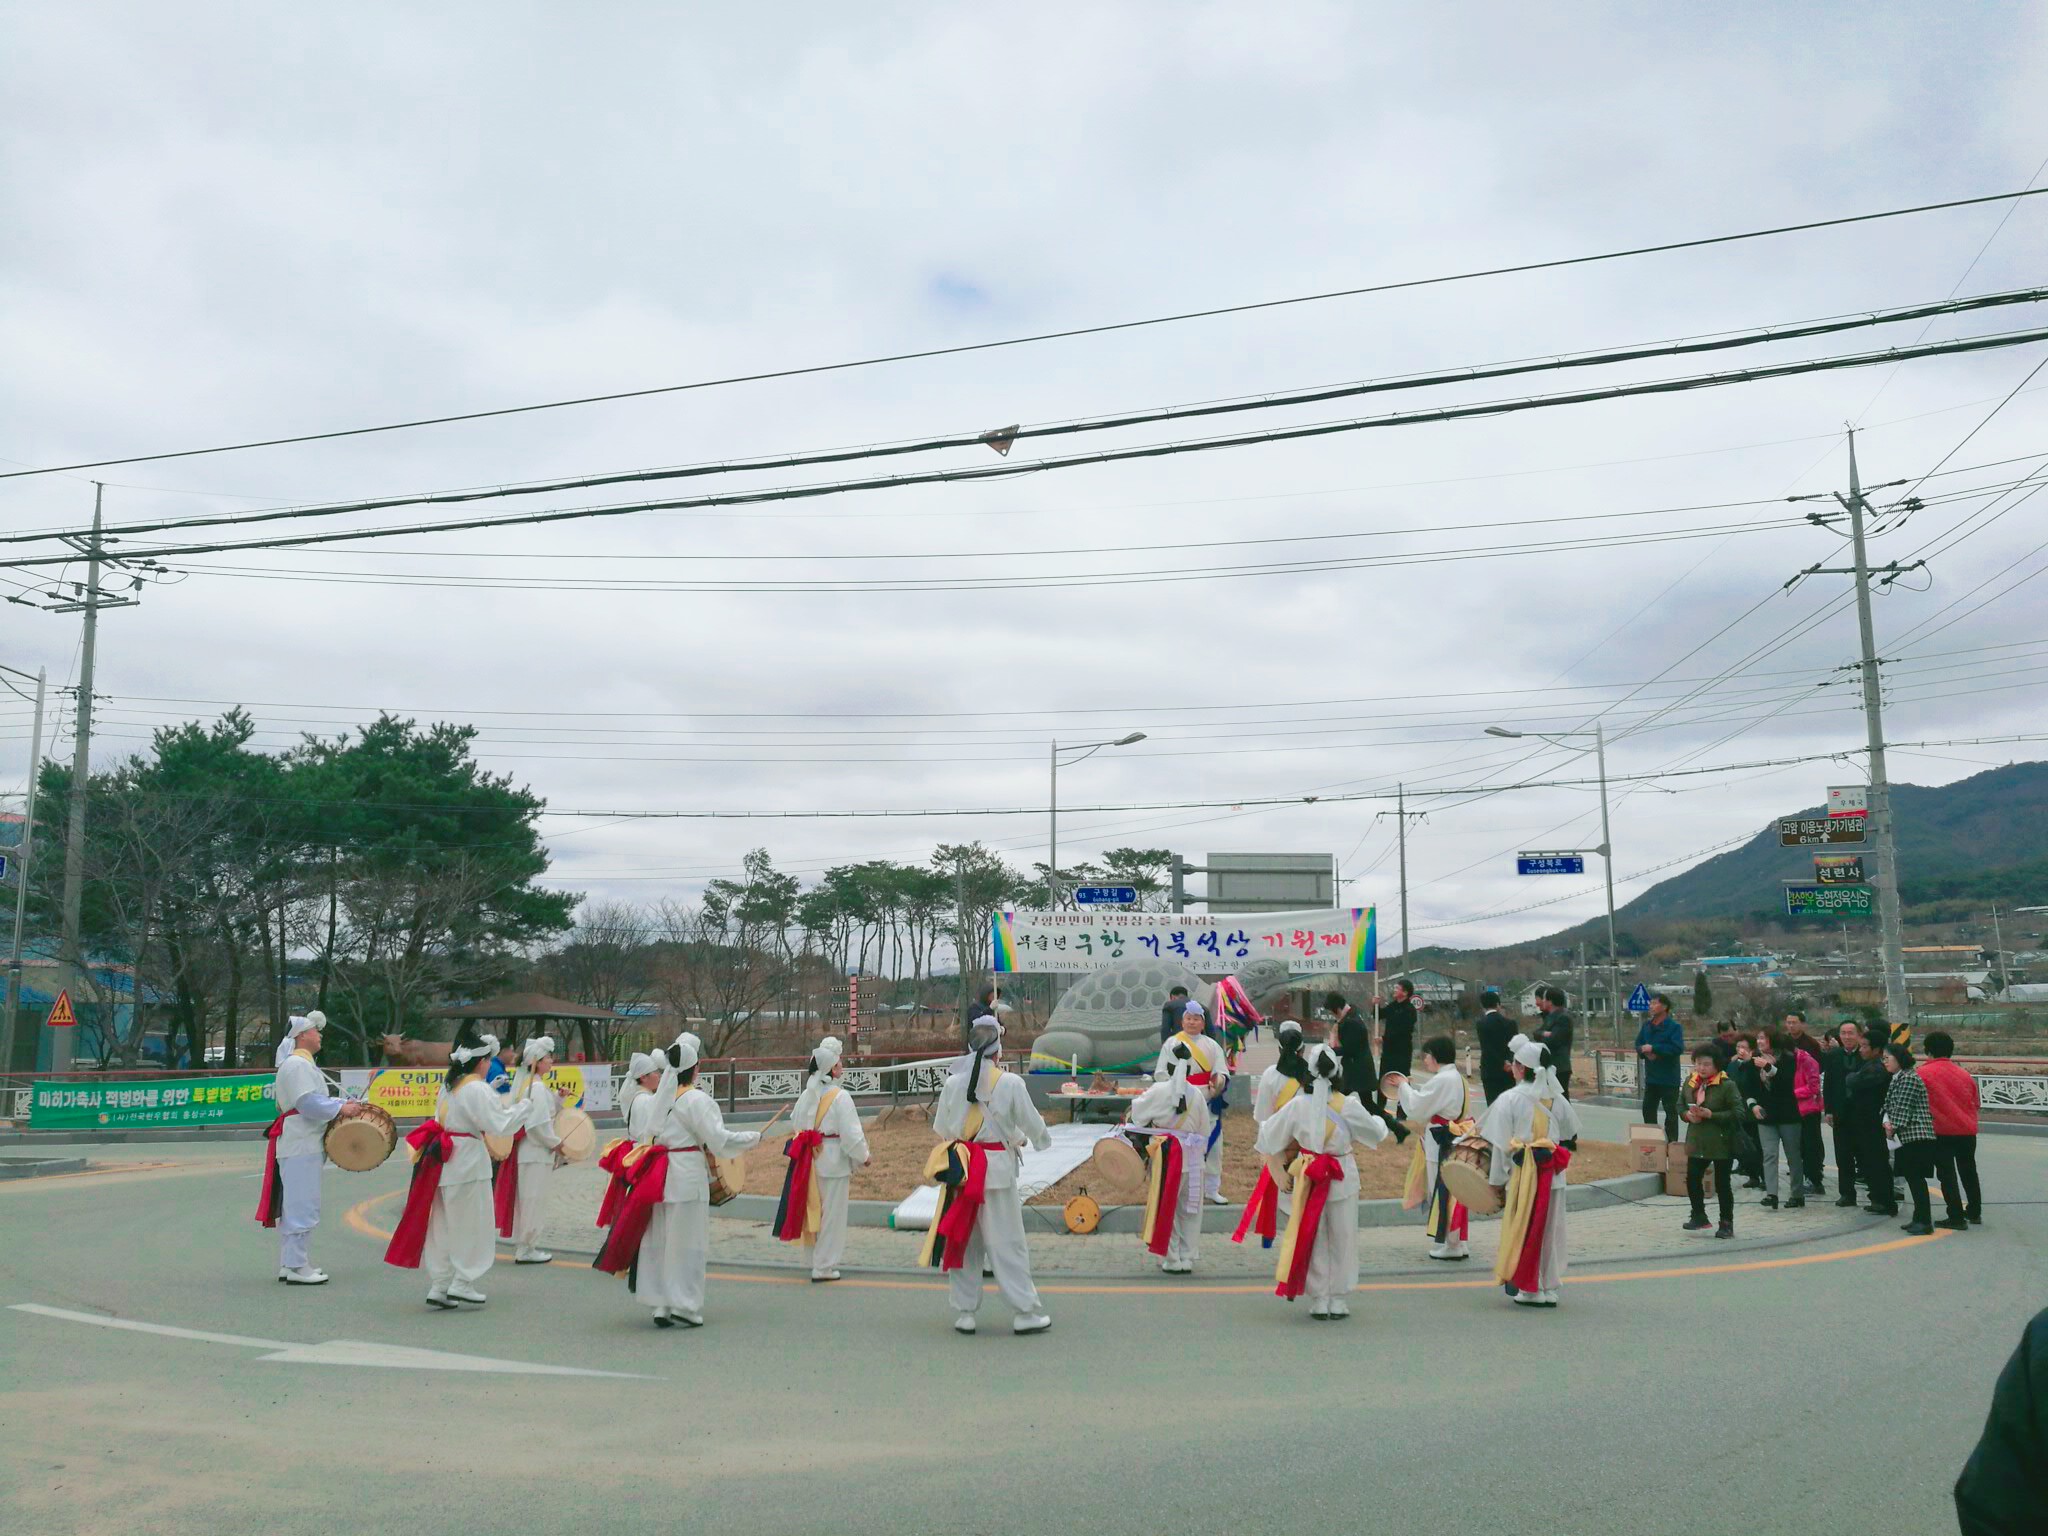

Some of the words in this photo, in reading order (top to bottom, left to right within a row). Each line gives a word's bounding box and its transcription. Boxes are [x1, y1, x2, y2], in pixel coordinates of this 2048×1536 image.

[1782, 822, 1798, 835] 고암
[1800, 818, 1863, 833] 이응노생가기념관
[1529, 859, 1563, 868] 구성북로
[1819, 867, 1861, 878] 석련사
[1093, 888, 1118, 897] 구항길
[1815, 890, 1869, 908] 농협정육식당
[1016, 934, 1067, 951] 무술년
[1075, 929, 1126, 958] 구항
[1137, 930, 1250, 958] 거북석상
[1262, 929, 1347, 956] 기원제
[105, 1089, 159, 1108] 적법화를
[162, 1088, 190, 1106] 위한
[192, 1086, 233, 1103] 특별법
